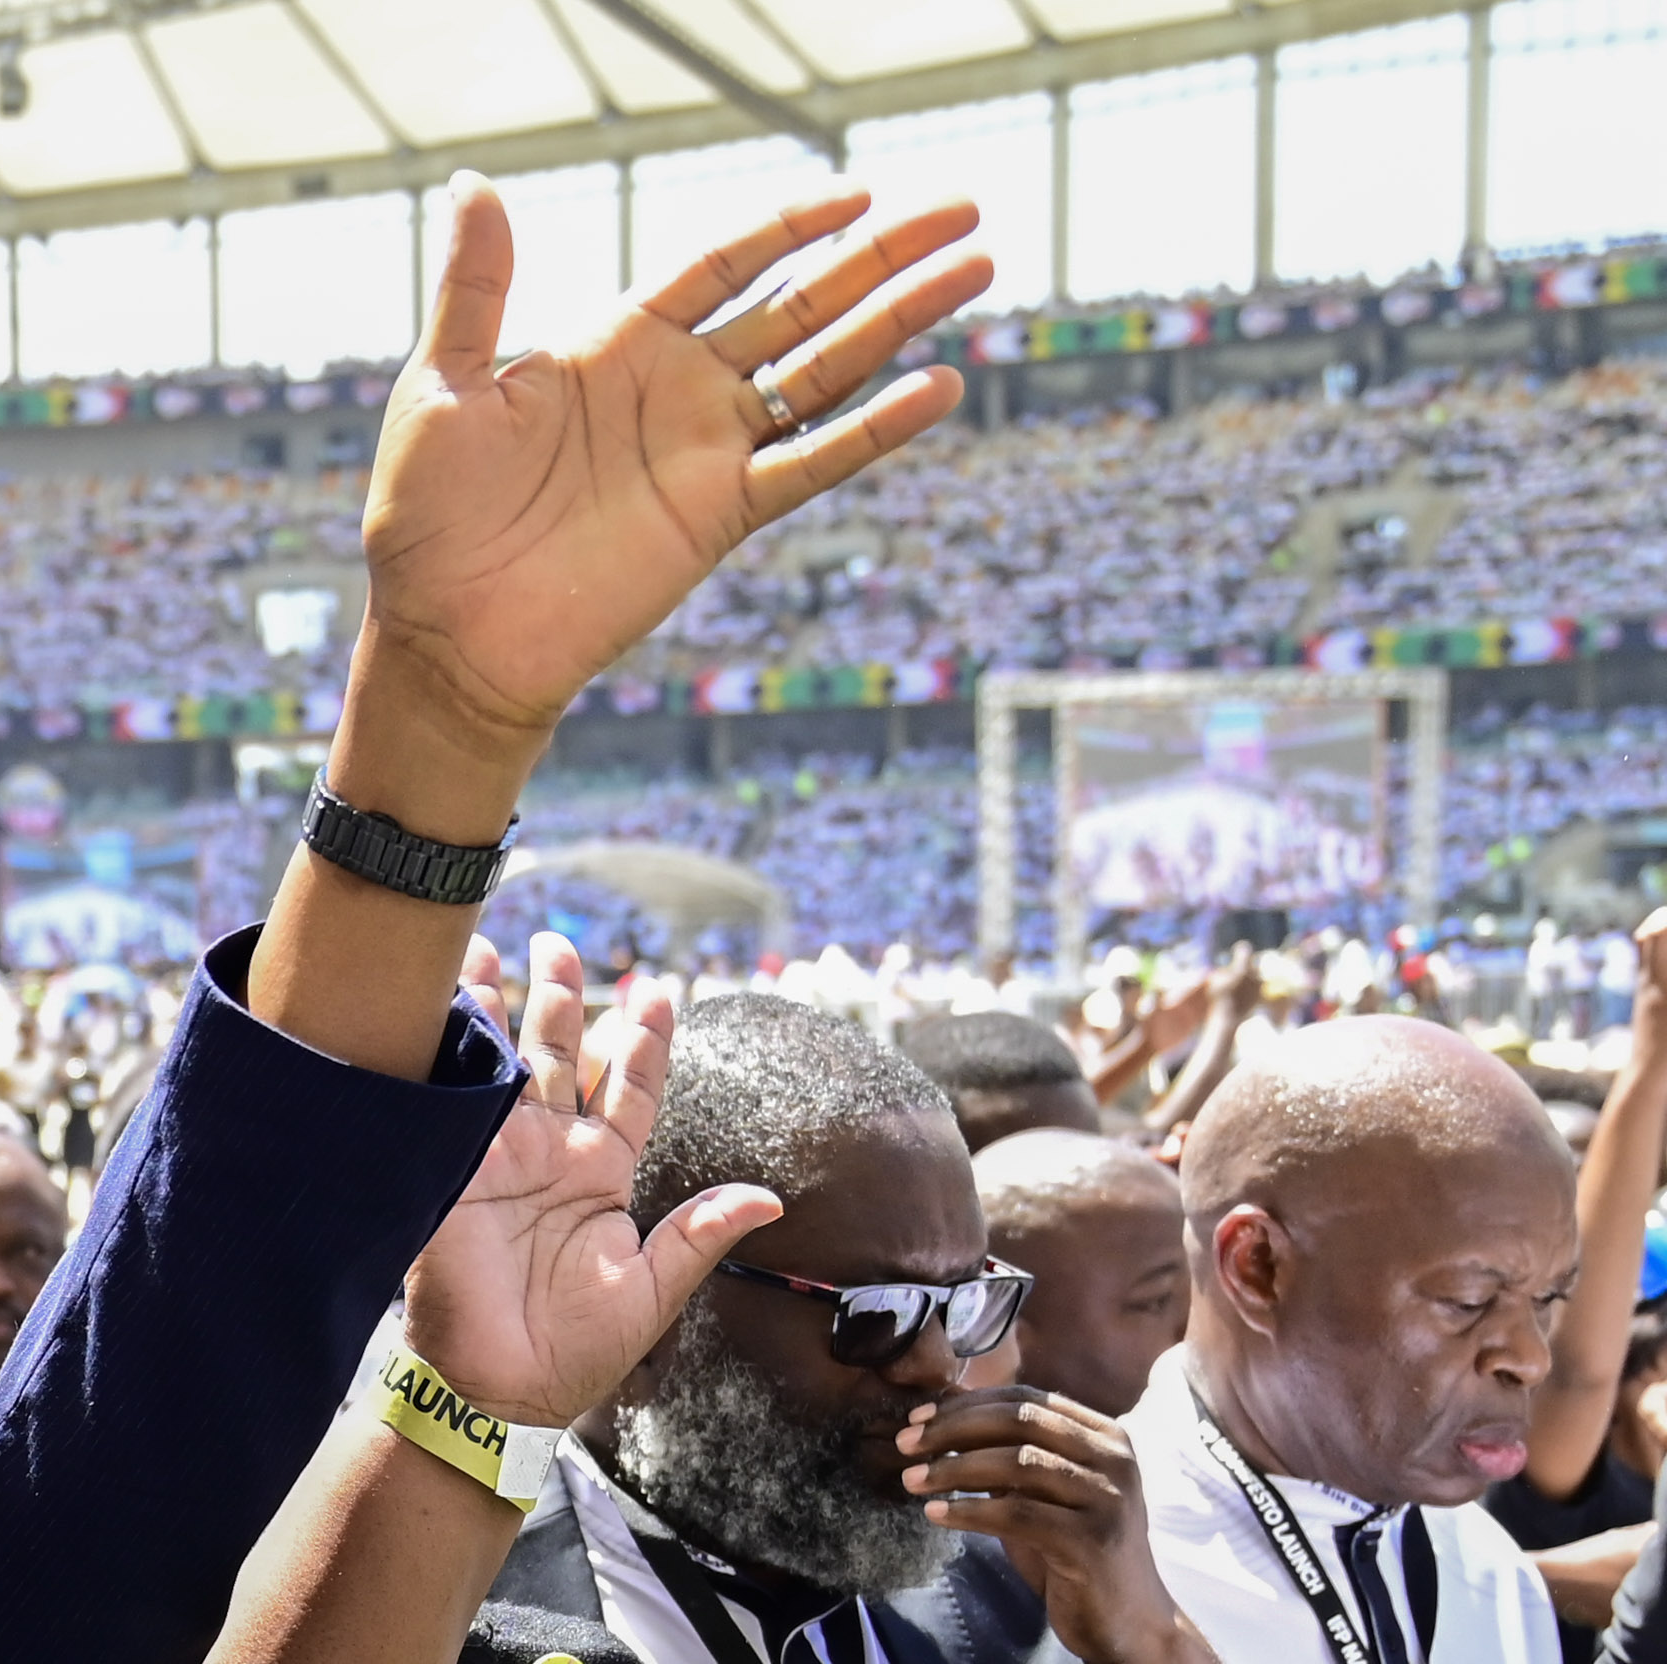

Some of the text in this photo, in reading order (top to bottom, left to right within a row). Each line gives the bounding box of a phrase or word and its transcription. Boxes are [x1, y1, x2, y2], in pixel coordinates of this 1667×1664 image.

[382, 1357, 508, 1457] LAUNCH
[1271, 1523, 1325, 1596] LAUNCH
[1326, 1613, 1353, 1644] IFP
